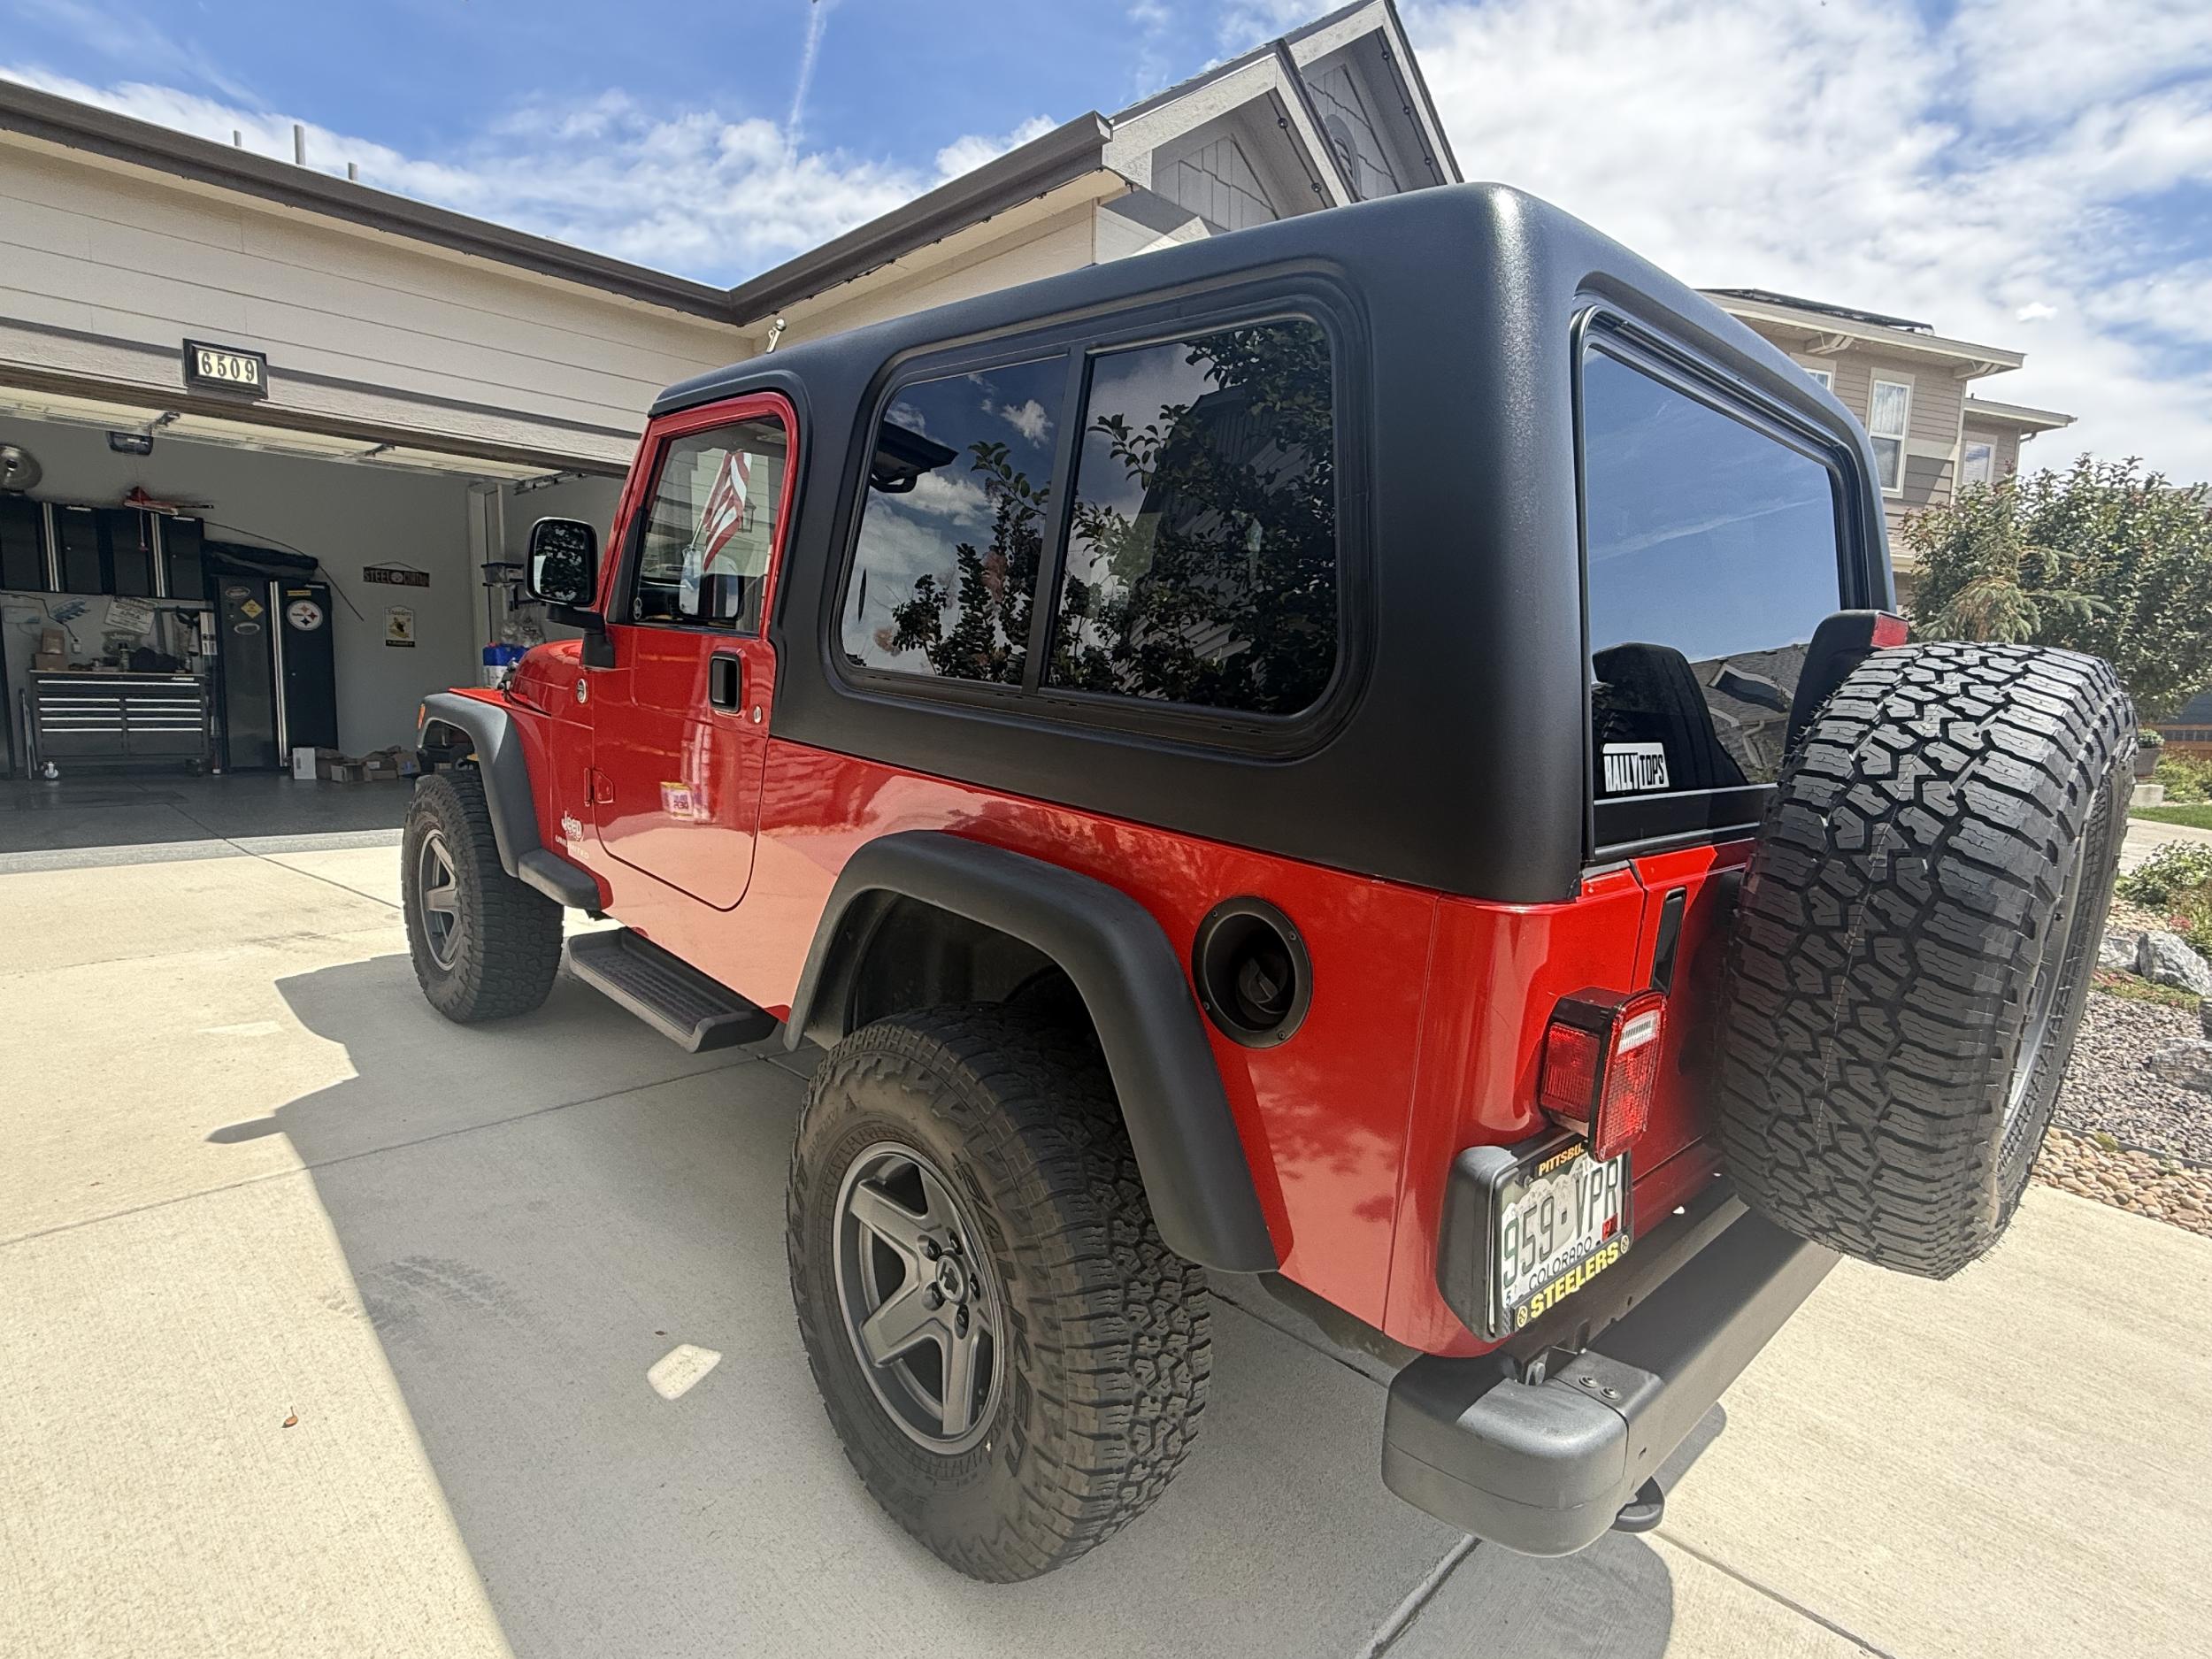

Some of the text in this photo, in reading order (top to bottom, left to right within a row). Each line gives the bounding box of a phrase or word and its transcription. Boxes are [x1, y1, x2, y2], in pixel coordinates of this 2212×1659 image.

[202, 352, 255, 381] 6509
[364, 569, 391, 584] STEEL
[561, 810, 583, 842] Jeep
[1529, 1236, 1592, 1291] COLORADO
[1530, 1241, 1619, 1319] STEELERS
[950, 1152, 1033, 1478] FALKEN
